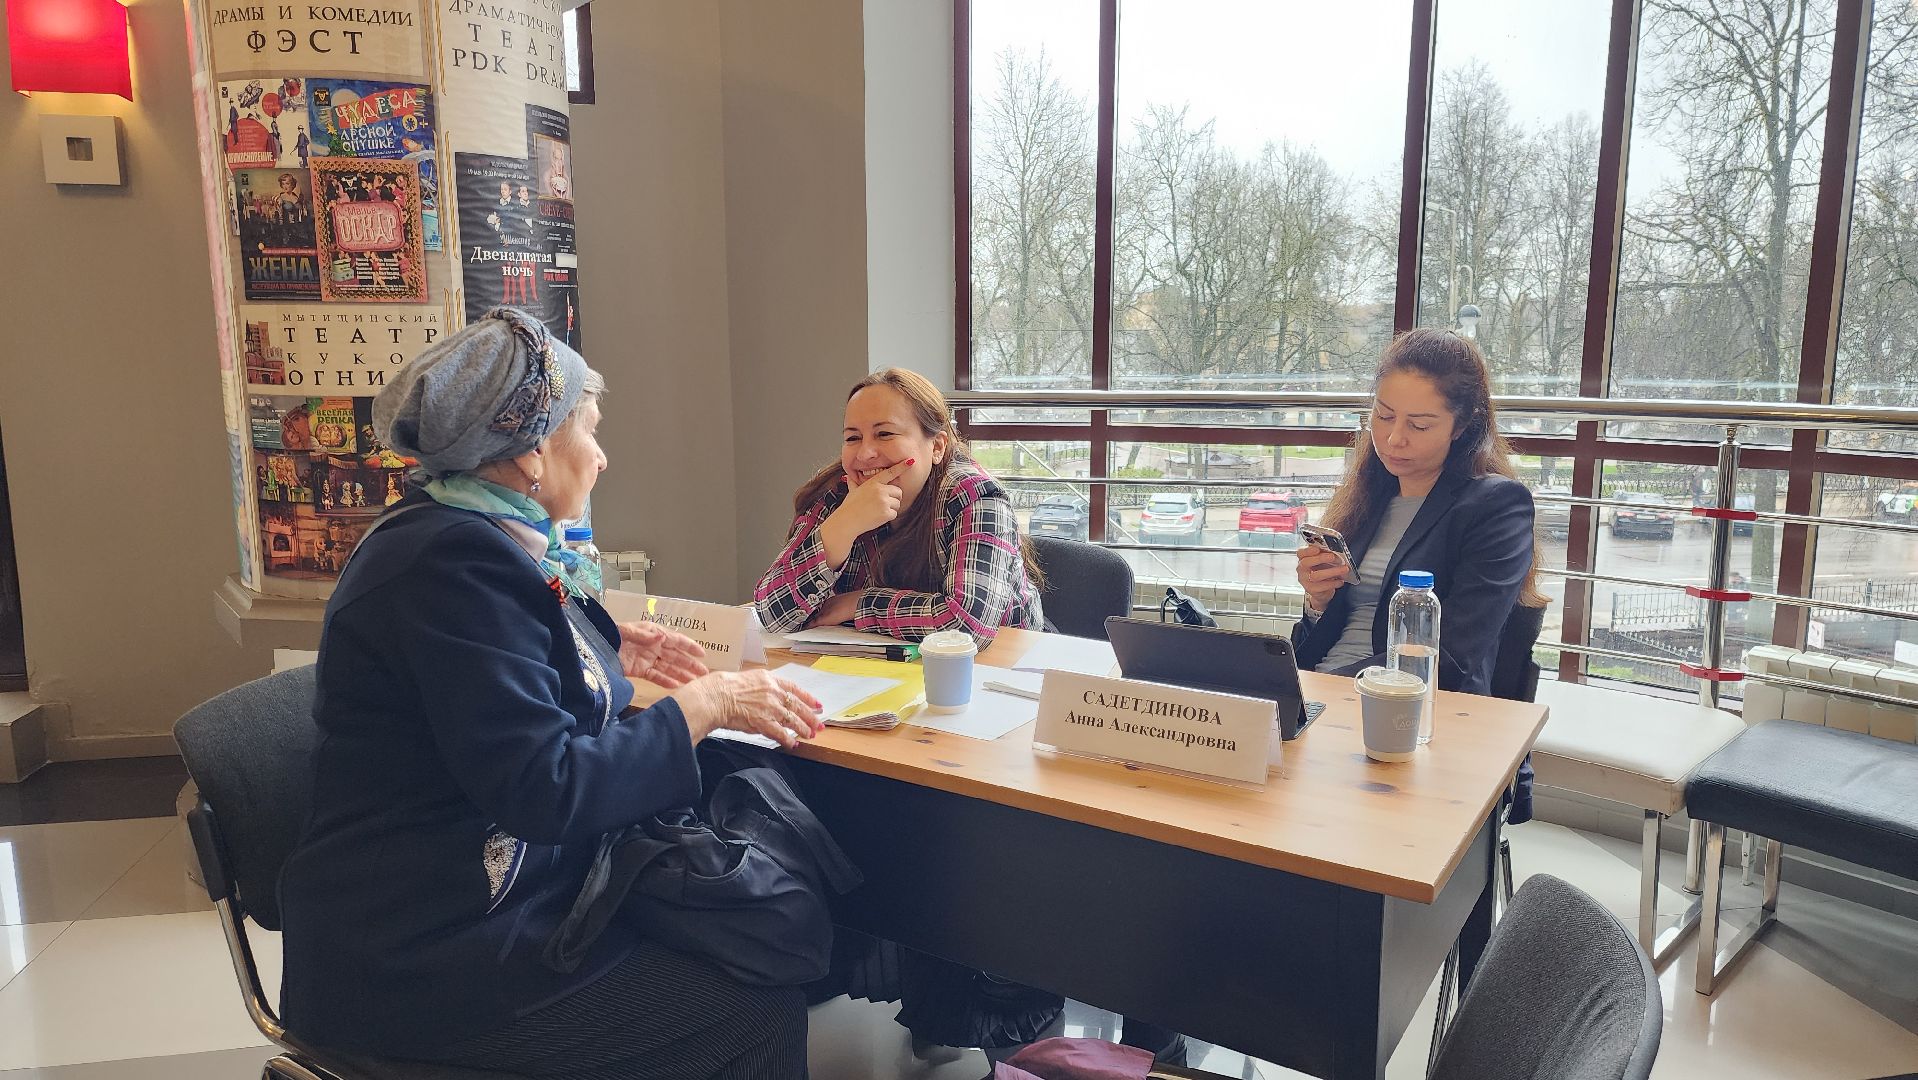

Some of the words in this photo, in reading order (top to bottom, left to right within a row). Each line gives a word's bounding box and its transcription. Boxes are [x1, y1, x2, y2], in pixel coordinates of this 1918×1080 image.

[213, 6, 265, 26] ДРАМЫ
[278, 6, 293, 20] И
[308, 6, 414, 26] КОМЕДИИ
[449, 0, 563, 42] ДРАМАТИЧЕСК
[246, 29, 363, 54] ФЭСТ
[452, 47, 508, 75] PDK
[526, 62, 568, 93] DRAM
[335, 90, 418, 123] ЧУДЕСА
[340, 122, 397, 140] ЛЕСНОЙ
[342, 137, 395, 152] ОПУШКЕ
[340, 213, 397, 244] ОСКАР
[470, 246, 553, 264] Двенадцатая
[249, 257, 314, 281] ЖЕНА
[501, 265, 534, 277] ночь
[282, 314, 437, 323] МЫТИЩИНСКИЙ
[284, 328, 437, 344] ТЕАТР
[287, 353, 403, 365] КУКО
[288, 370, 386, 386] ОГНИ
[317, 416, 354, 424] РЕПКА
[1083, 690, 1222, 726] САДЕТДИНОВА
[1065, 709, 1105, 728] Анна
[1108, 717, 1237, 752] Александровна
